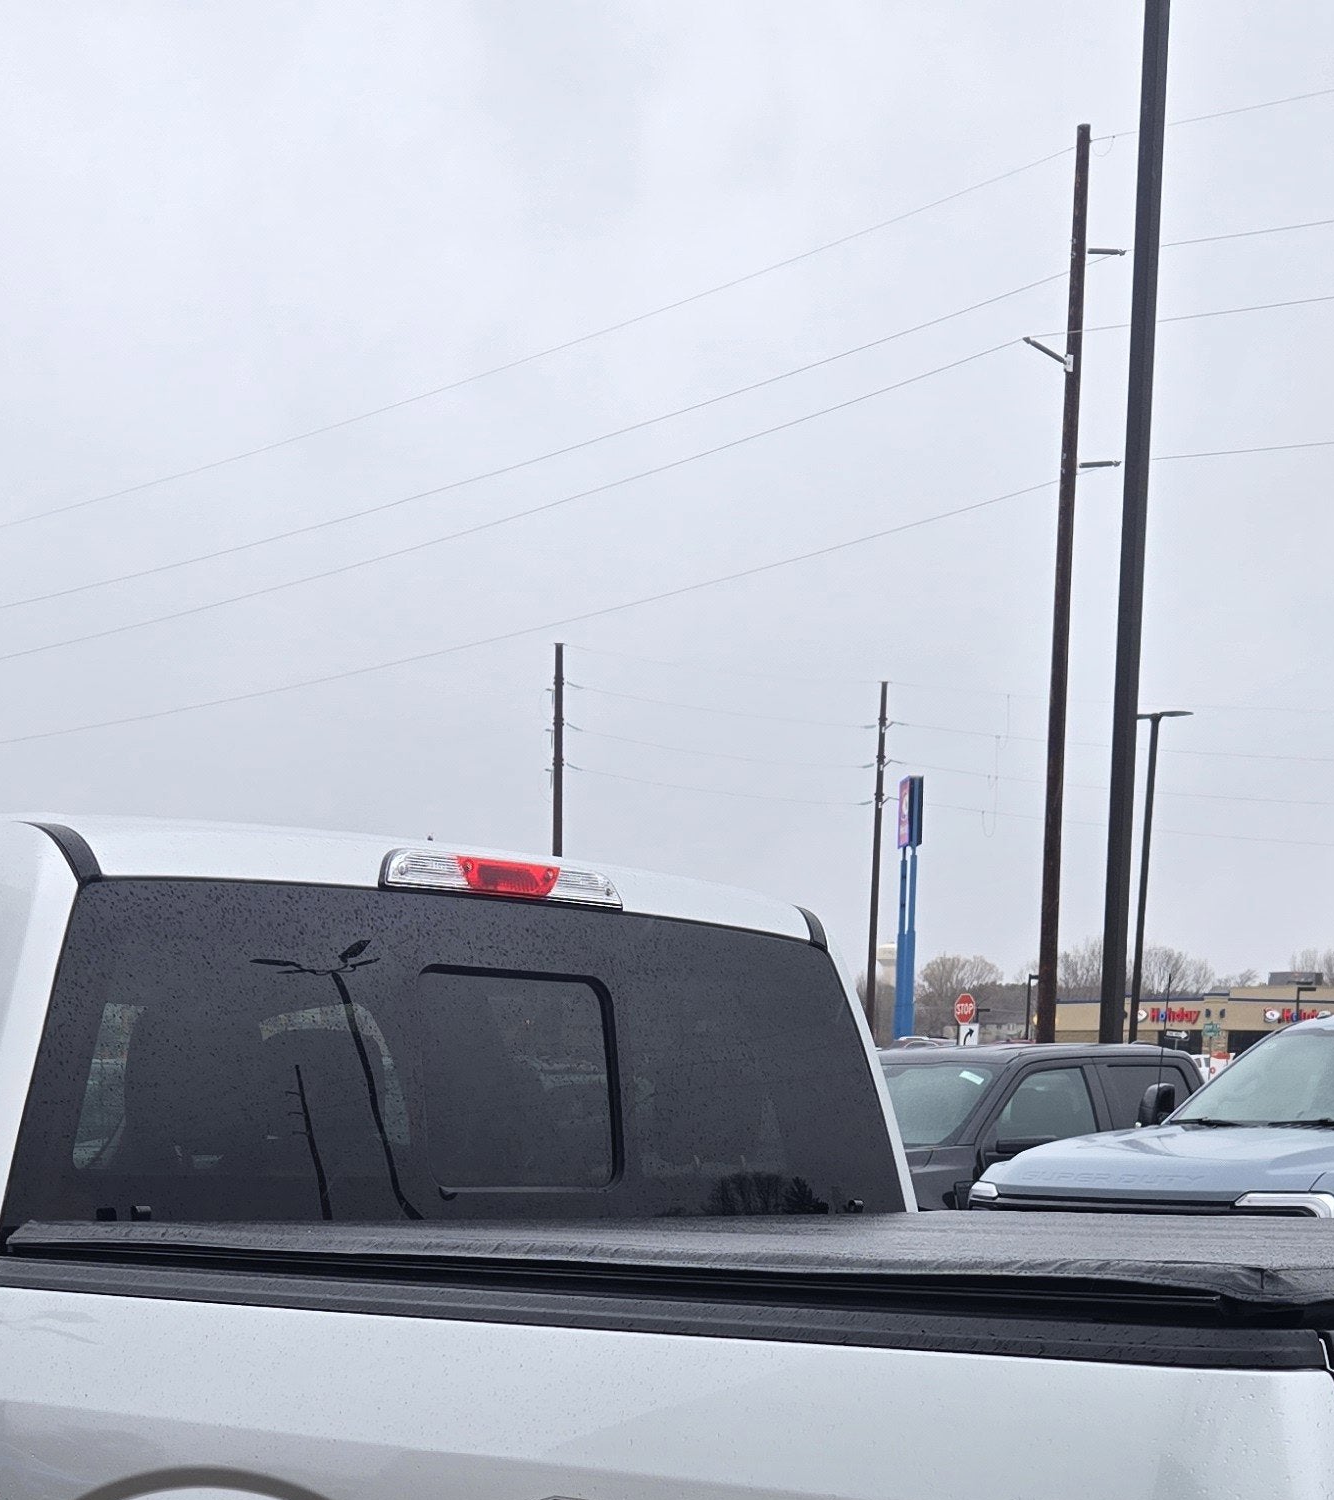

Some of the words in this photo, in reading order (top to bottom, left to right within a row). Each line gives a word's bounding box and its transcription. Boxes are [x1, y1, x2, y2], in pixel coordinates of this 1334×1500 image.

[956, 1003, 973, 1015] STOP
[1150, 1007, 1200, 1024] Holiday
[1022, 1170, 1110, 1184] SUPER
[1118, 1173, 1205, 1185] DUTY
